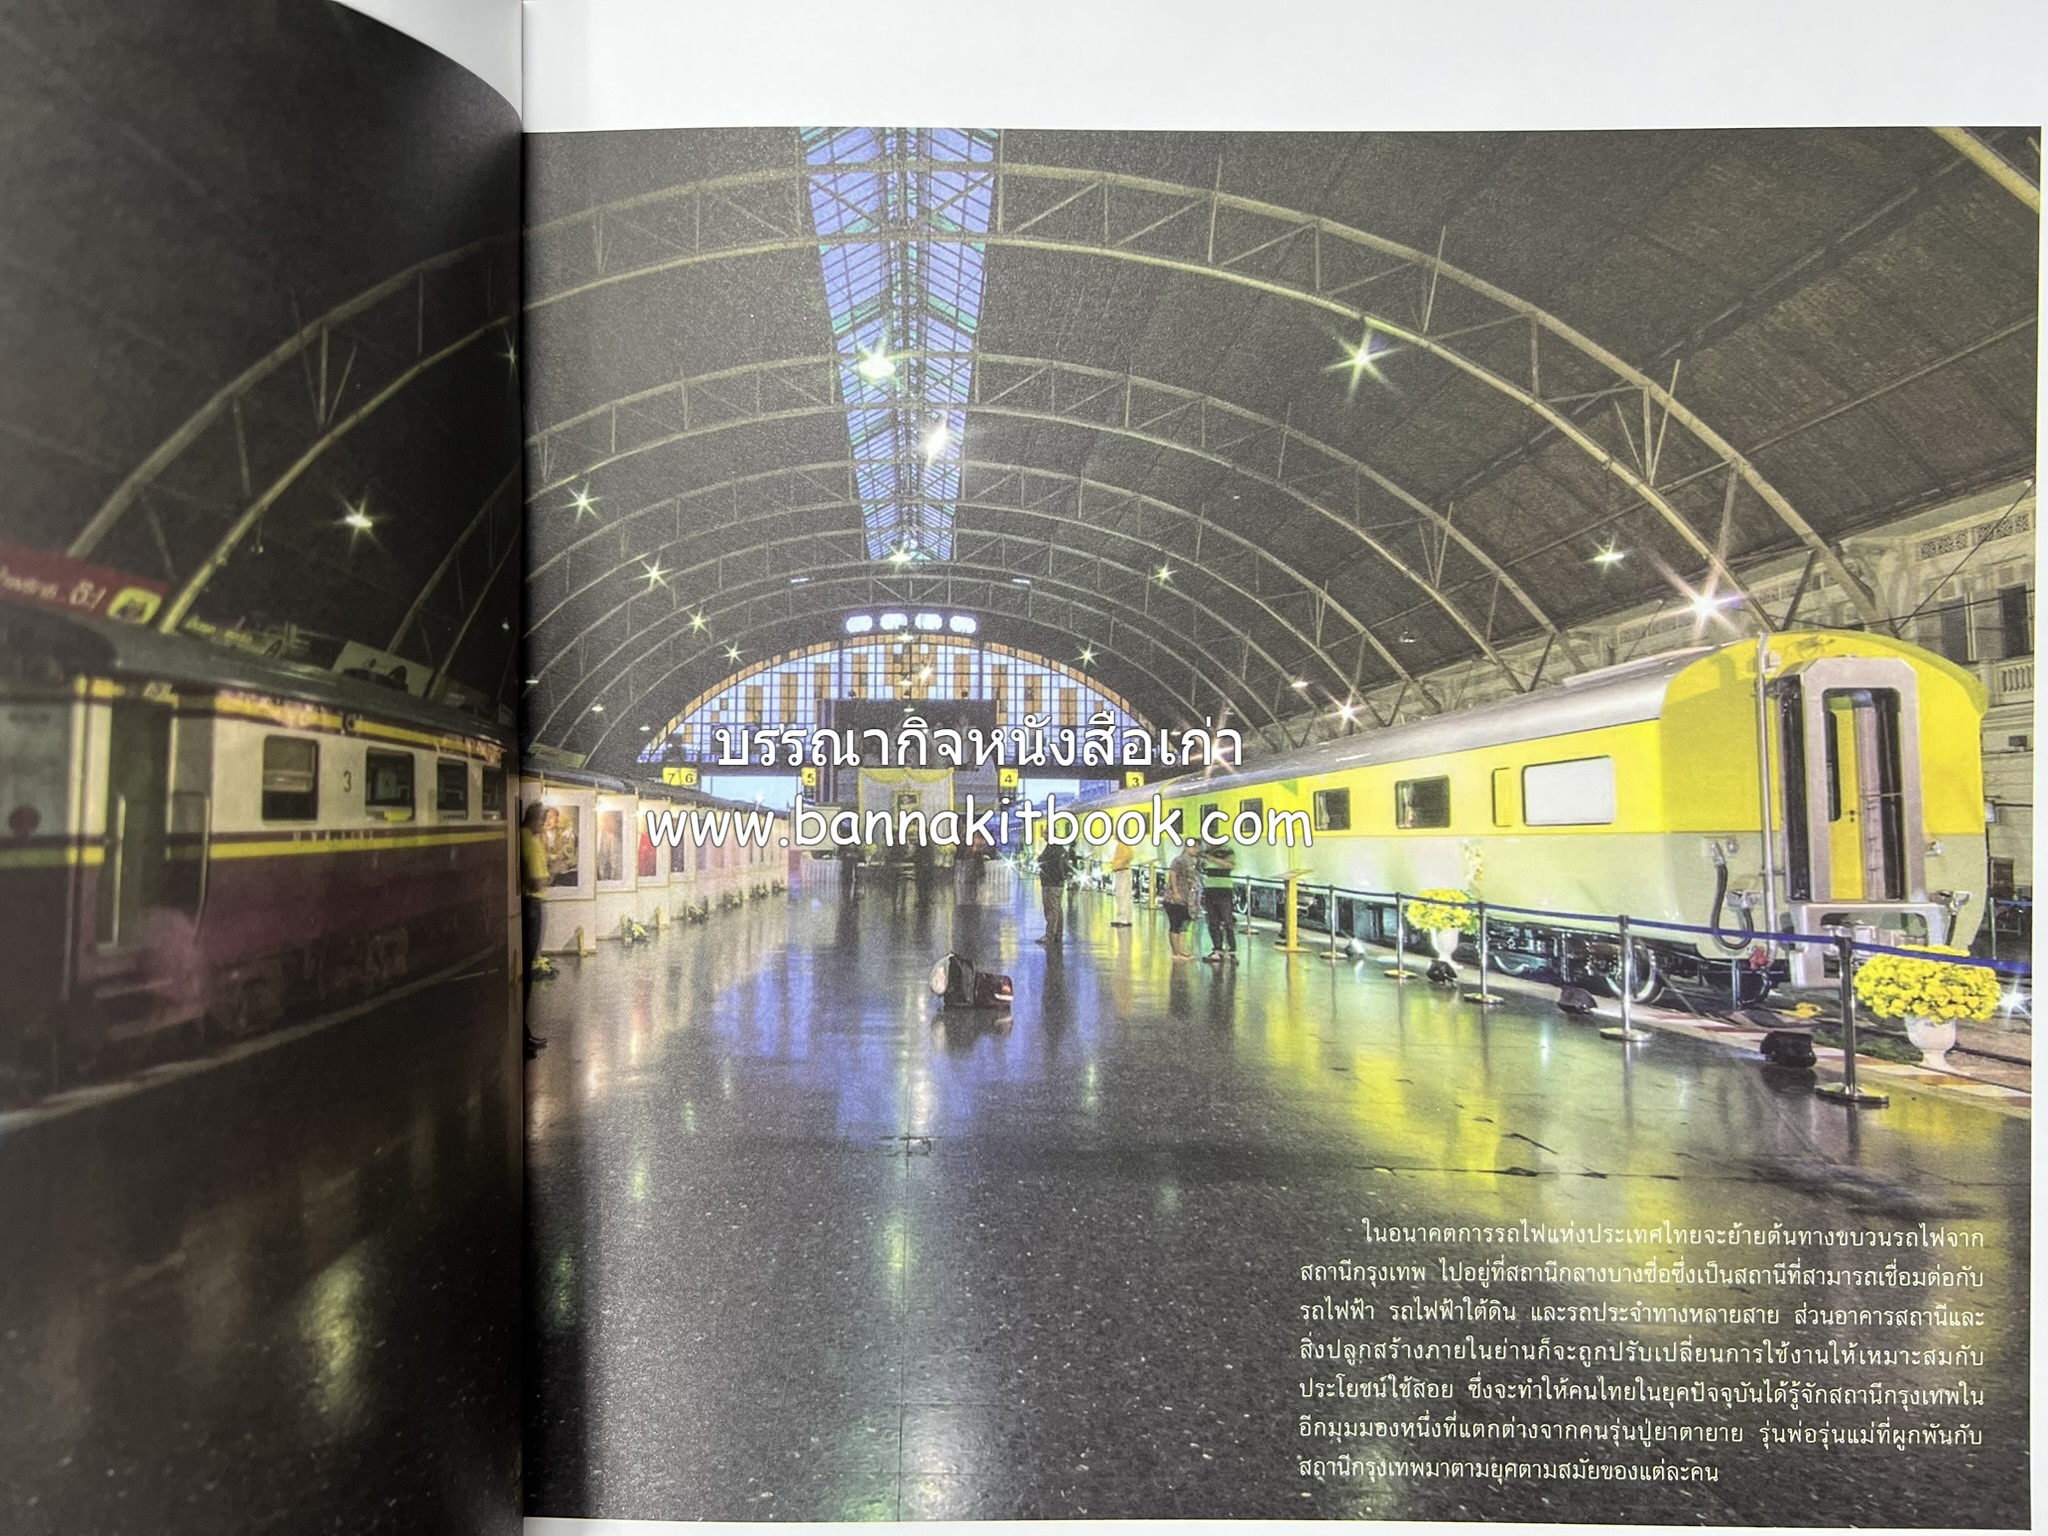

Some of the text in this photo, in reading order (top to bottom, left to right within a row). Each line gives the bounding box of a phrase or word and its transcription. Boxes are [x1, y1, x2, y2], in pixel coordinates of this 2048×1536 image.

[343, 770, 352, 793] 3
[685, 773, 694, 784] 6
[806, 773, 815, 784] 5
[1004, 773, 1013, 783] 4
[1132, 777, 1140, 788] 3
[1361, 1217, 1984, 1248] ในอนาคตการรถไฟแห่งประเทศไทยจะย้ายต้นทางขบวนรถไฟจาก
[1300, 1255, 1984, 1289] สถานีกรุงเทพ ไปอยู่ที่สถานีกลางบางซื่อซึ่งเป็นสถานีที่สามารถเชื่อมต่อกับ
[1300, 1295, 1985, 1327] รถไฟฟ้า รถไฟฟ้าใต้ดิน และรถประจำทางหลายสาย ส่วนอาคารสถานีและ
[1300, 1332, 1984, 1367] สิ่งปลูกสร้างภายในย่านก็จะถูกปรับเปลี่ยนการใช้งานให้เหมาะสมกับ
[1299, 1371, 1984, 1411] ประโยชน์ใช้สอย ซึ่งจะทำให้คนไทยในยุคปัจจุบันได้รู้จักสถานีกรุงเทพใน
[1758, 1416, 1983, 1451] รุ่นพ่อรุ่นแม่ที่ผูกพันกับ
[1299, 1453, 1719, 1485] สถานีกรุงเทพมาตามยุคตามสมัยของแต่ละคน
